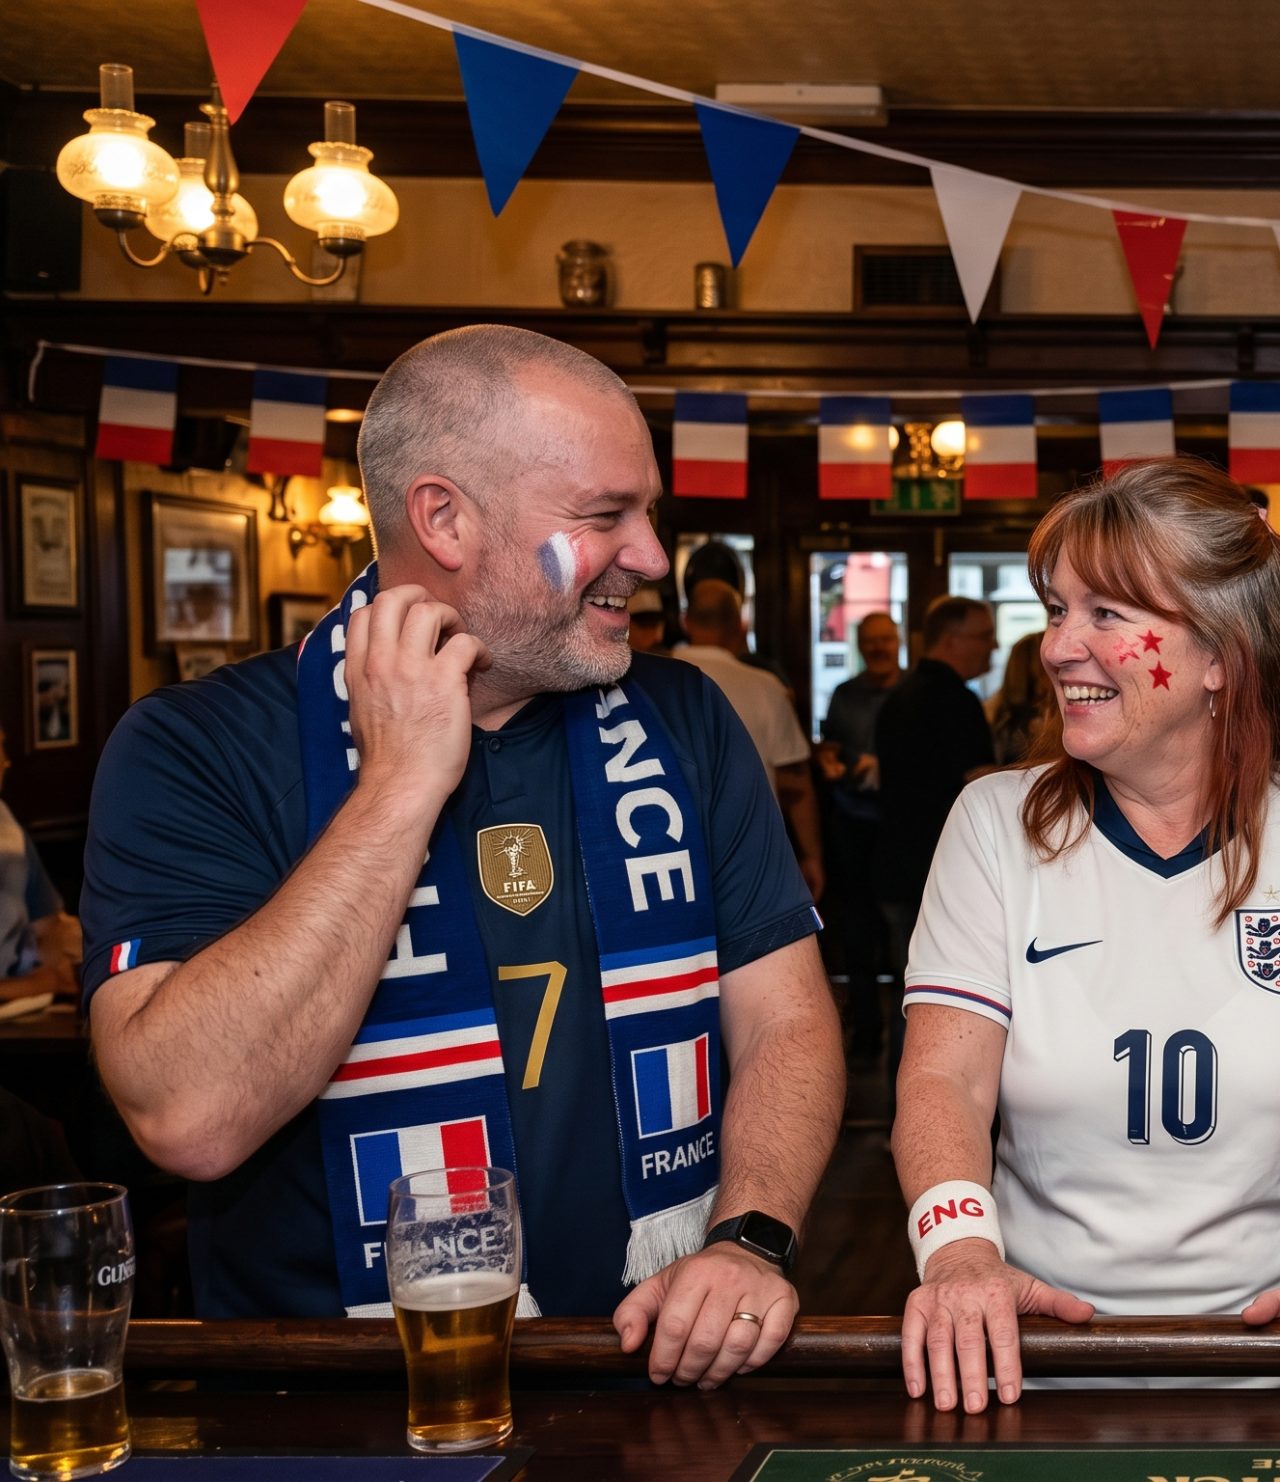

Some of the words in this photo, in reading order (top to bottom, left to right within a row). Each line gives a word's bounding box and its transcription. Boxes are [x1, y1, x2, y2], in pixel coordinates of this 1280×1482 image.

[503, 880, 536, 893] FIFA
[498, 961, 567, 1090] 7
[1113, 1029, 1218, 1145] 10
[641, 1131, 715, 1180] FRANCE
[917, 1197, 985, 1239] ENG
